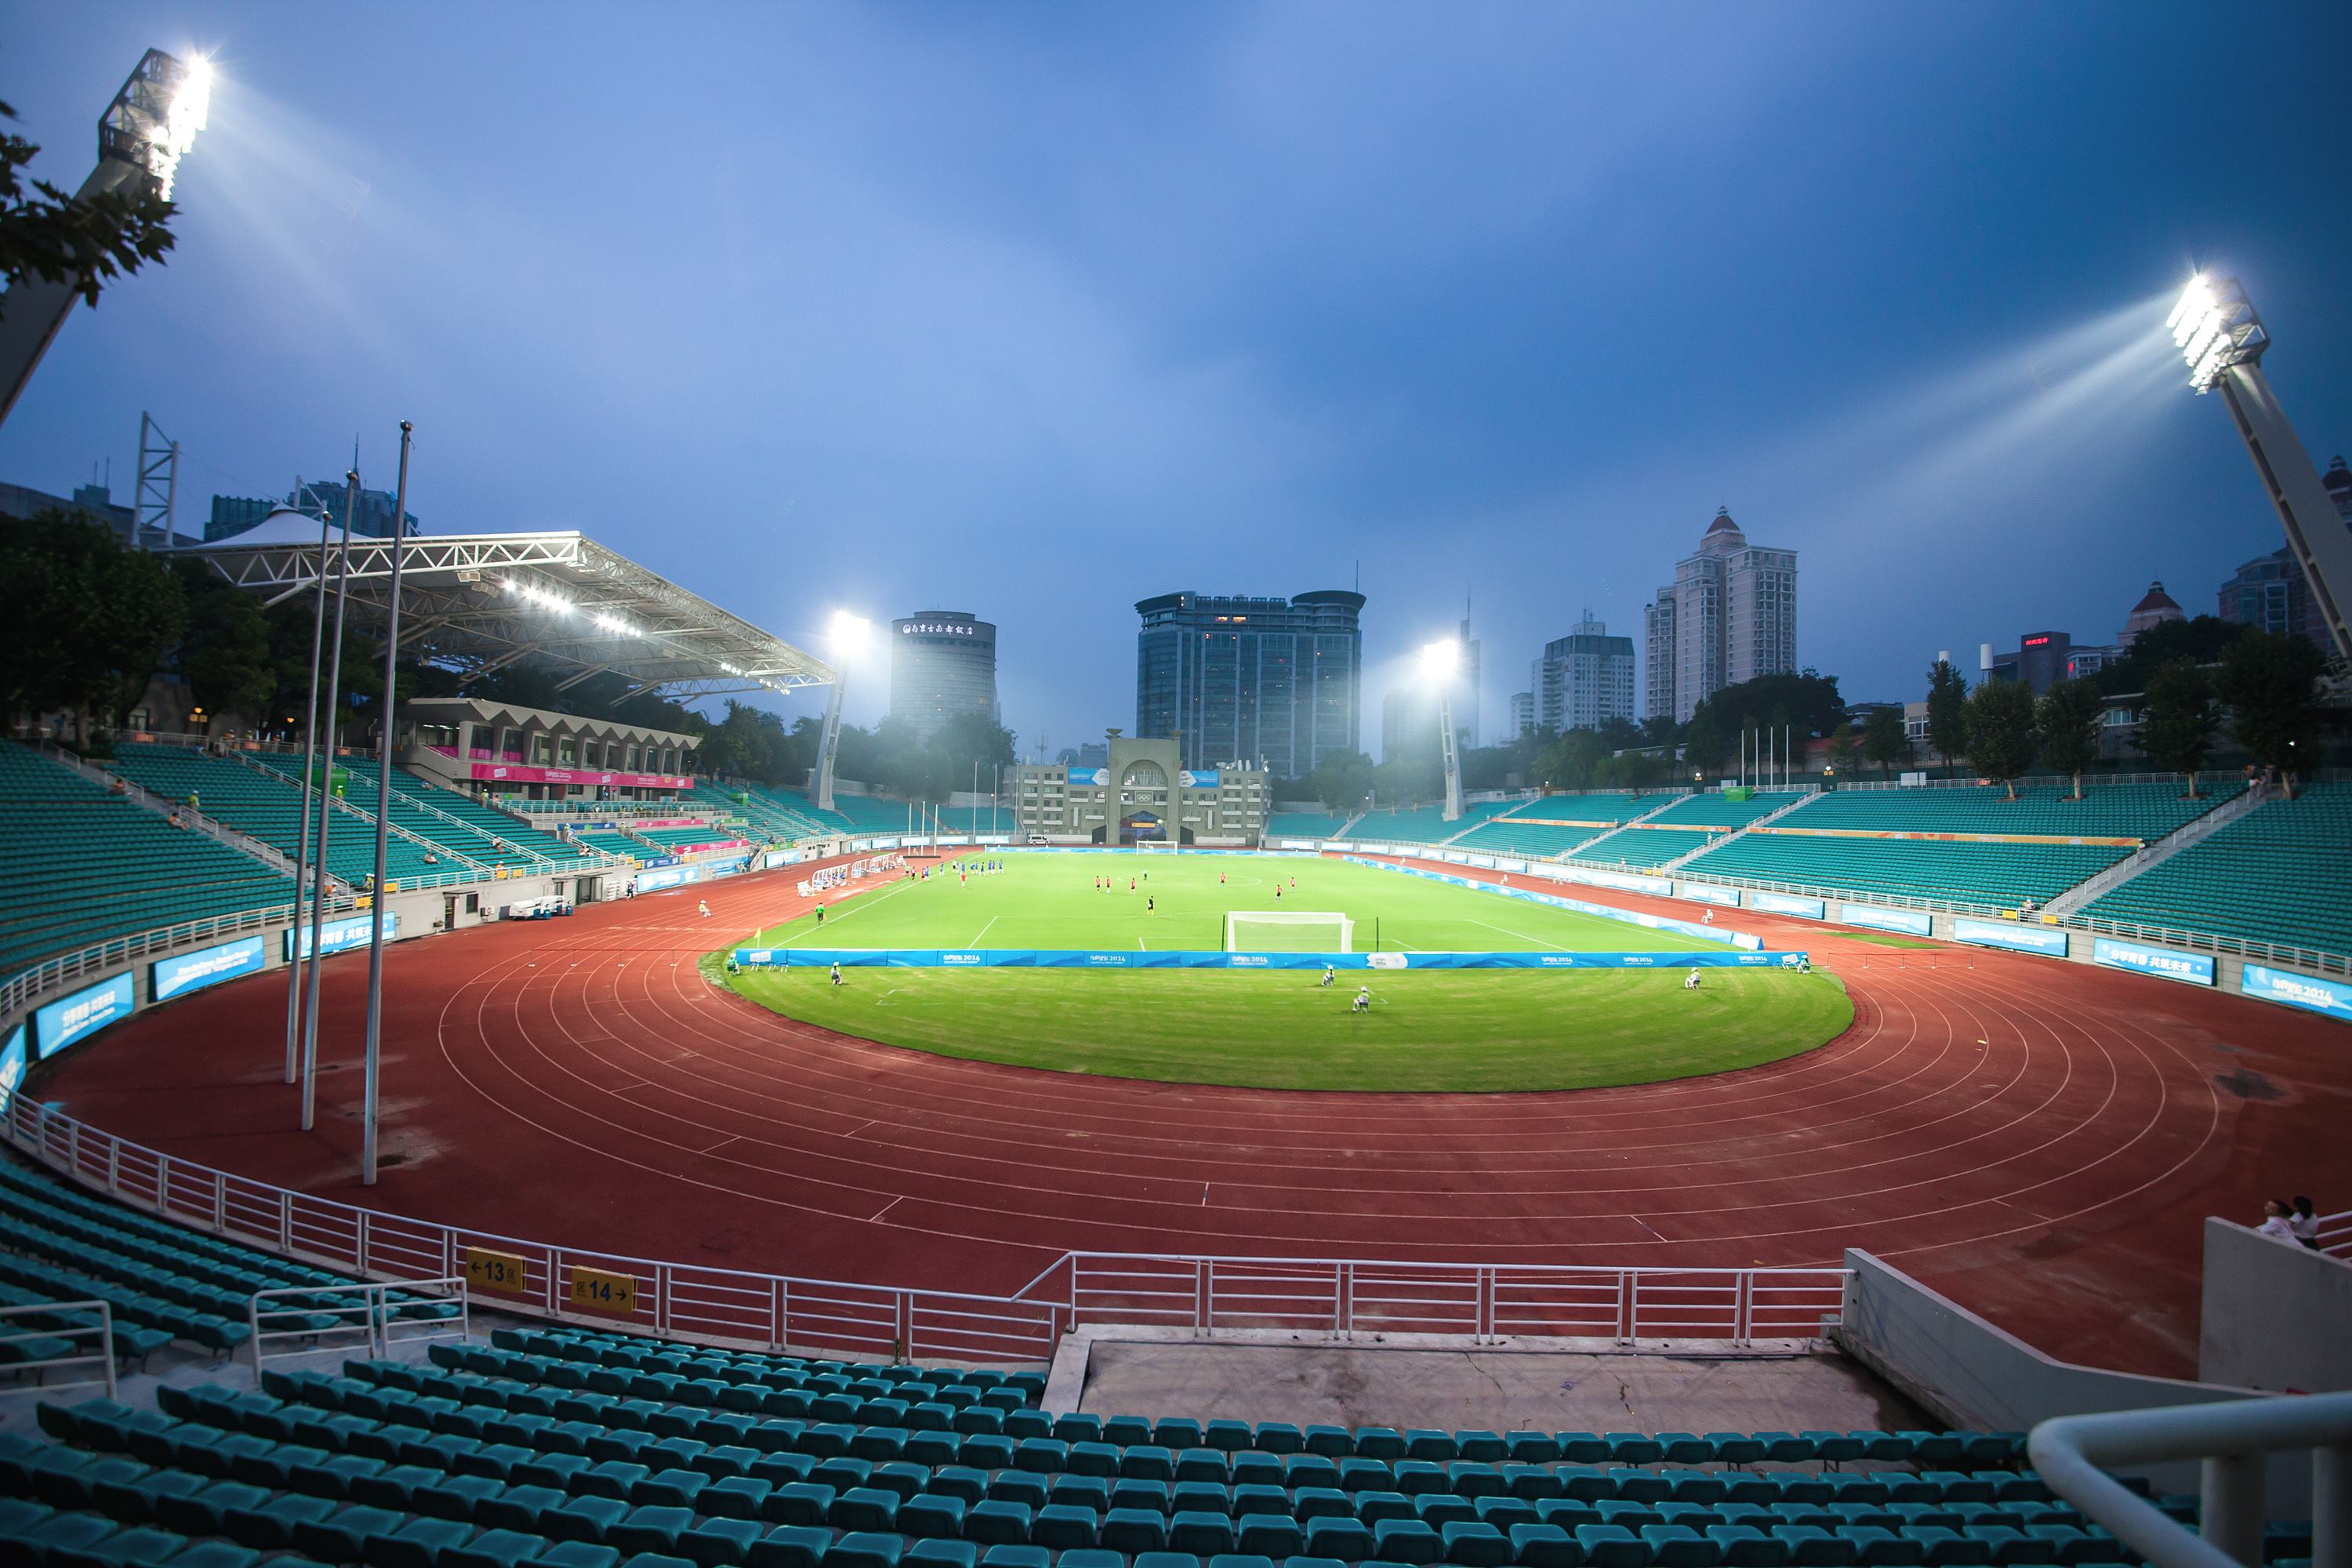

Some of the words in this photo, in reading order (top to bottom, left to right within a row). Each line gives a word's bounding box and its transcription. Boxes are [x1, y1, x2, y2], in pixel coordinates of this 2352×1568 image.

[2303, 985, 2334, 1005] 2014
[485, 1260, 505, 1283] 13
[590, 1279, 612, 1302] 14
